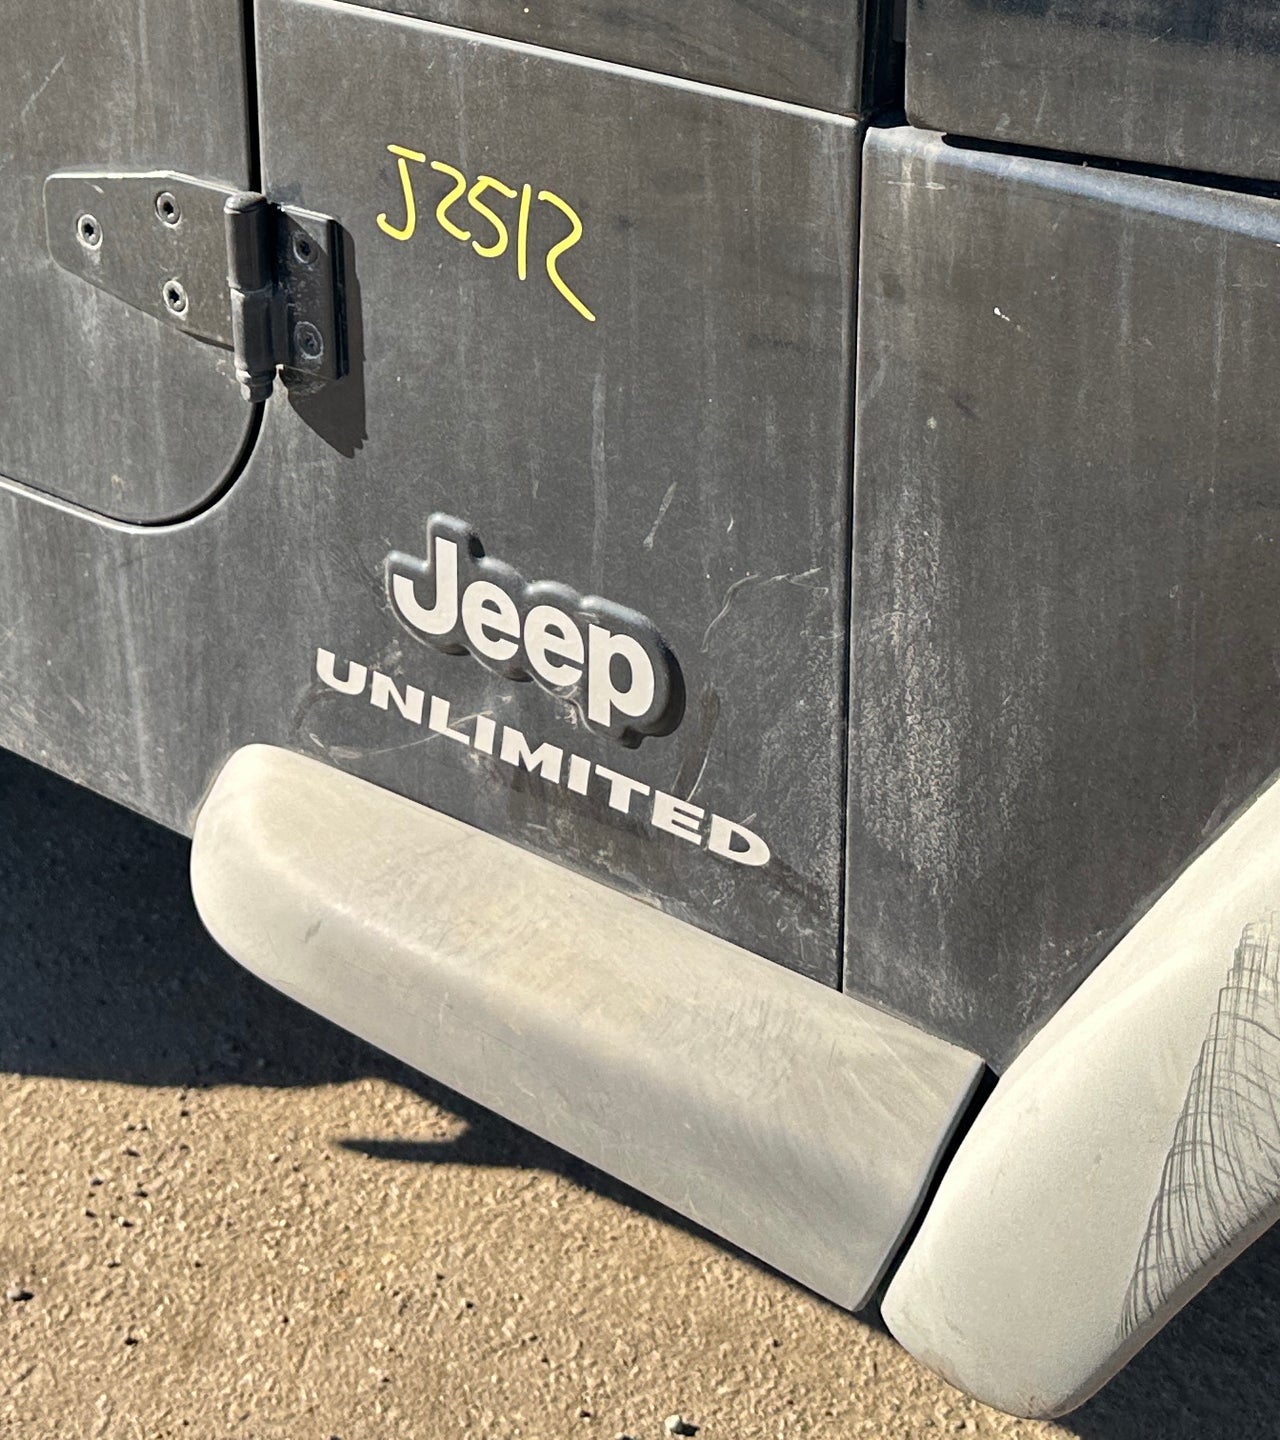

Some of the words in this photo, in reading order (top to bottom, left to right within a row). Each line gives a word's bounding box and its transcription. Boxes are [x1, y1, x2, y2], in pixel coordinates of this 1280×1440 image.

[376, 144, 596, 322] J2512
[393, 536, 656, 727] Jeep
[315, 647, 771, 866] UNLIMITED
